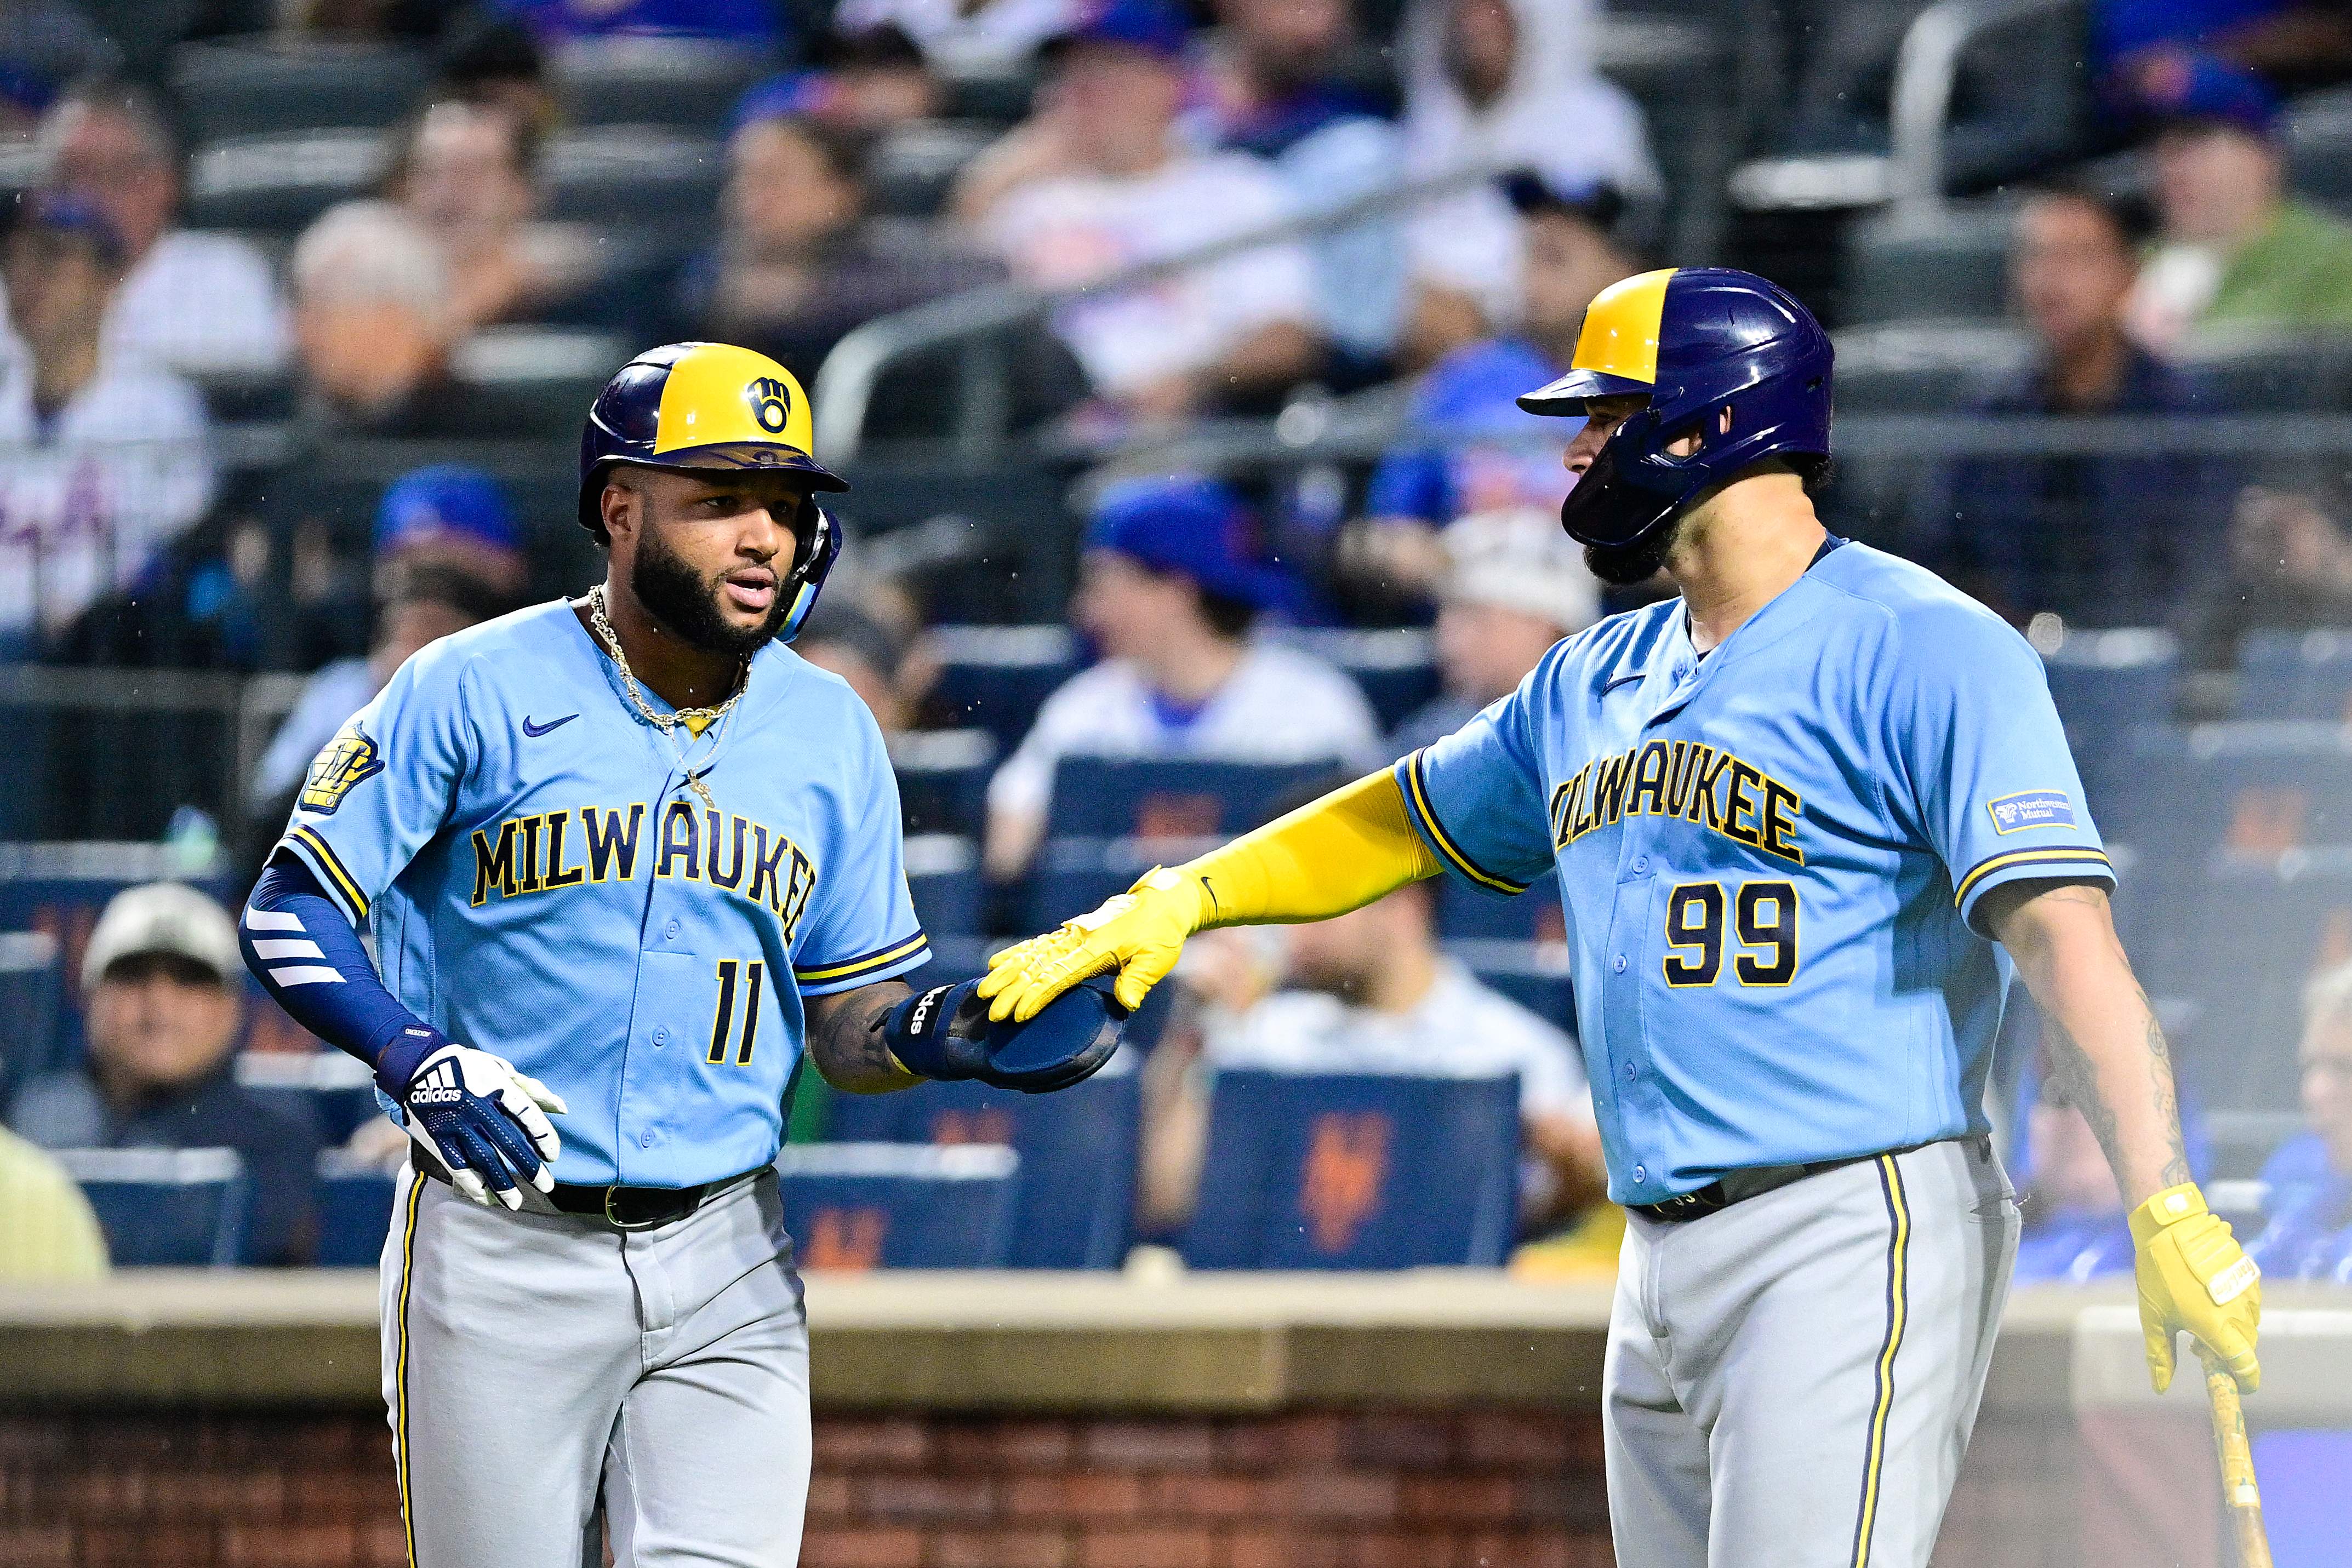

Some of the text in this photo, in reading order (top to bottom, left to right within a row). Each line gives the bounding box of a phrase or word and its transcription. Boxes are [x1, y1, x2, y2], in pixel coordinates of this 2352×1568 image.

[2020, 808, 2054, 820] Mutual
[1663, 880, 1800, 988] 99
[706, 959, 765, 1066] 11
[410, 1086, 462, 1104] adidas
